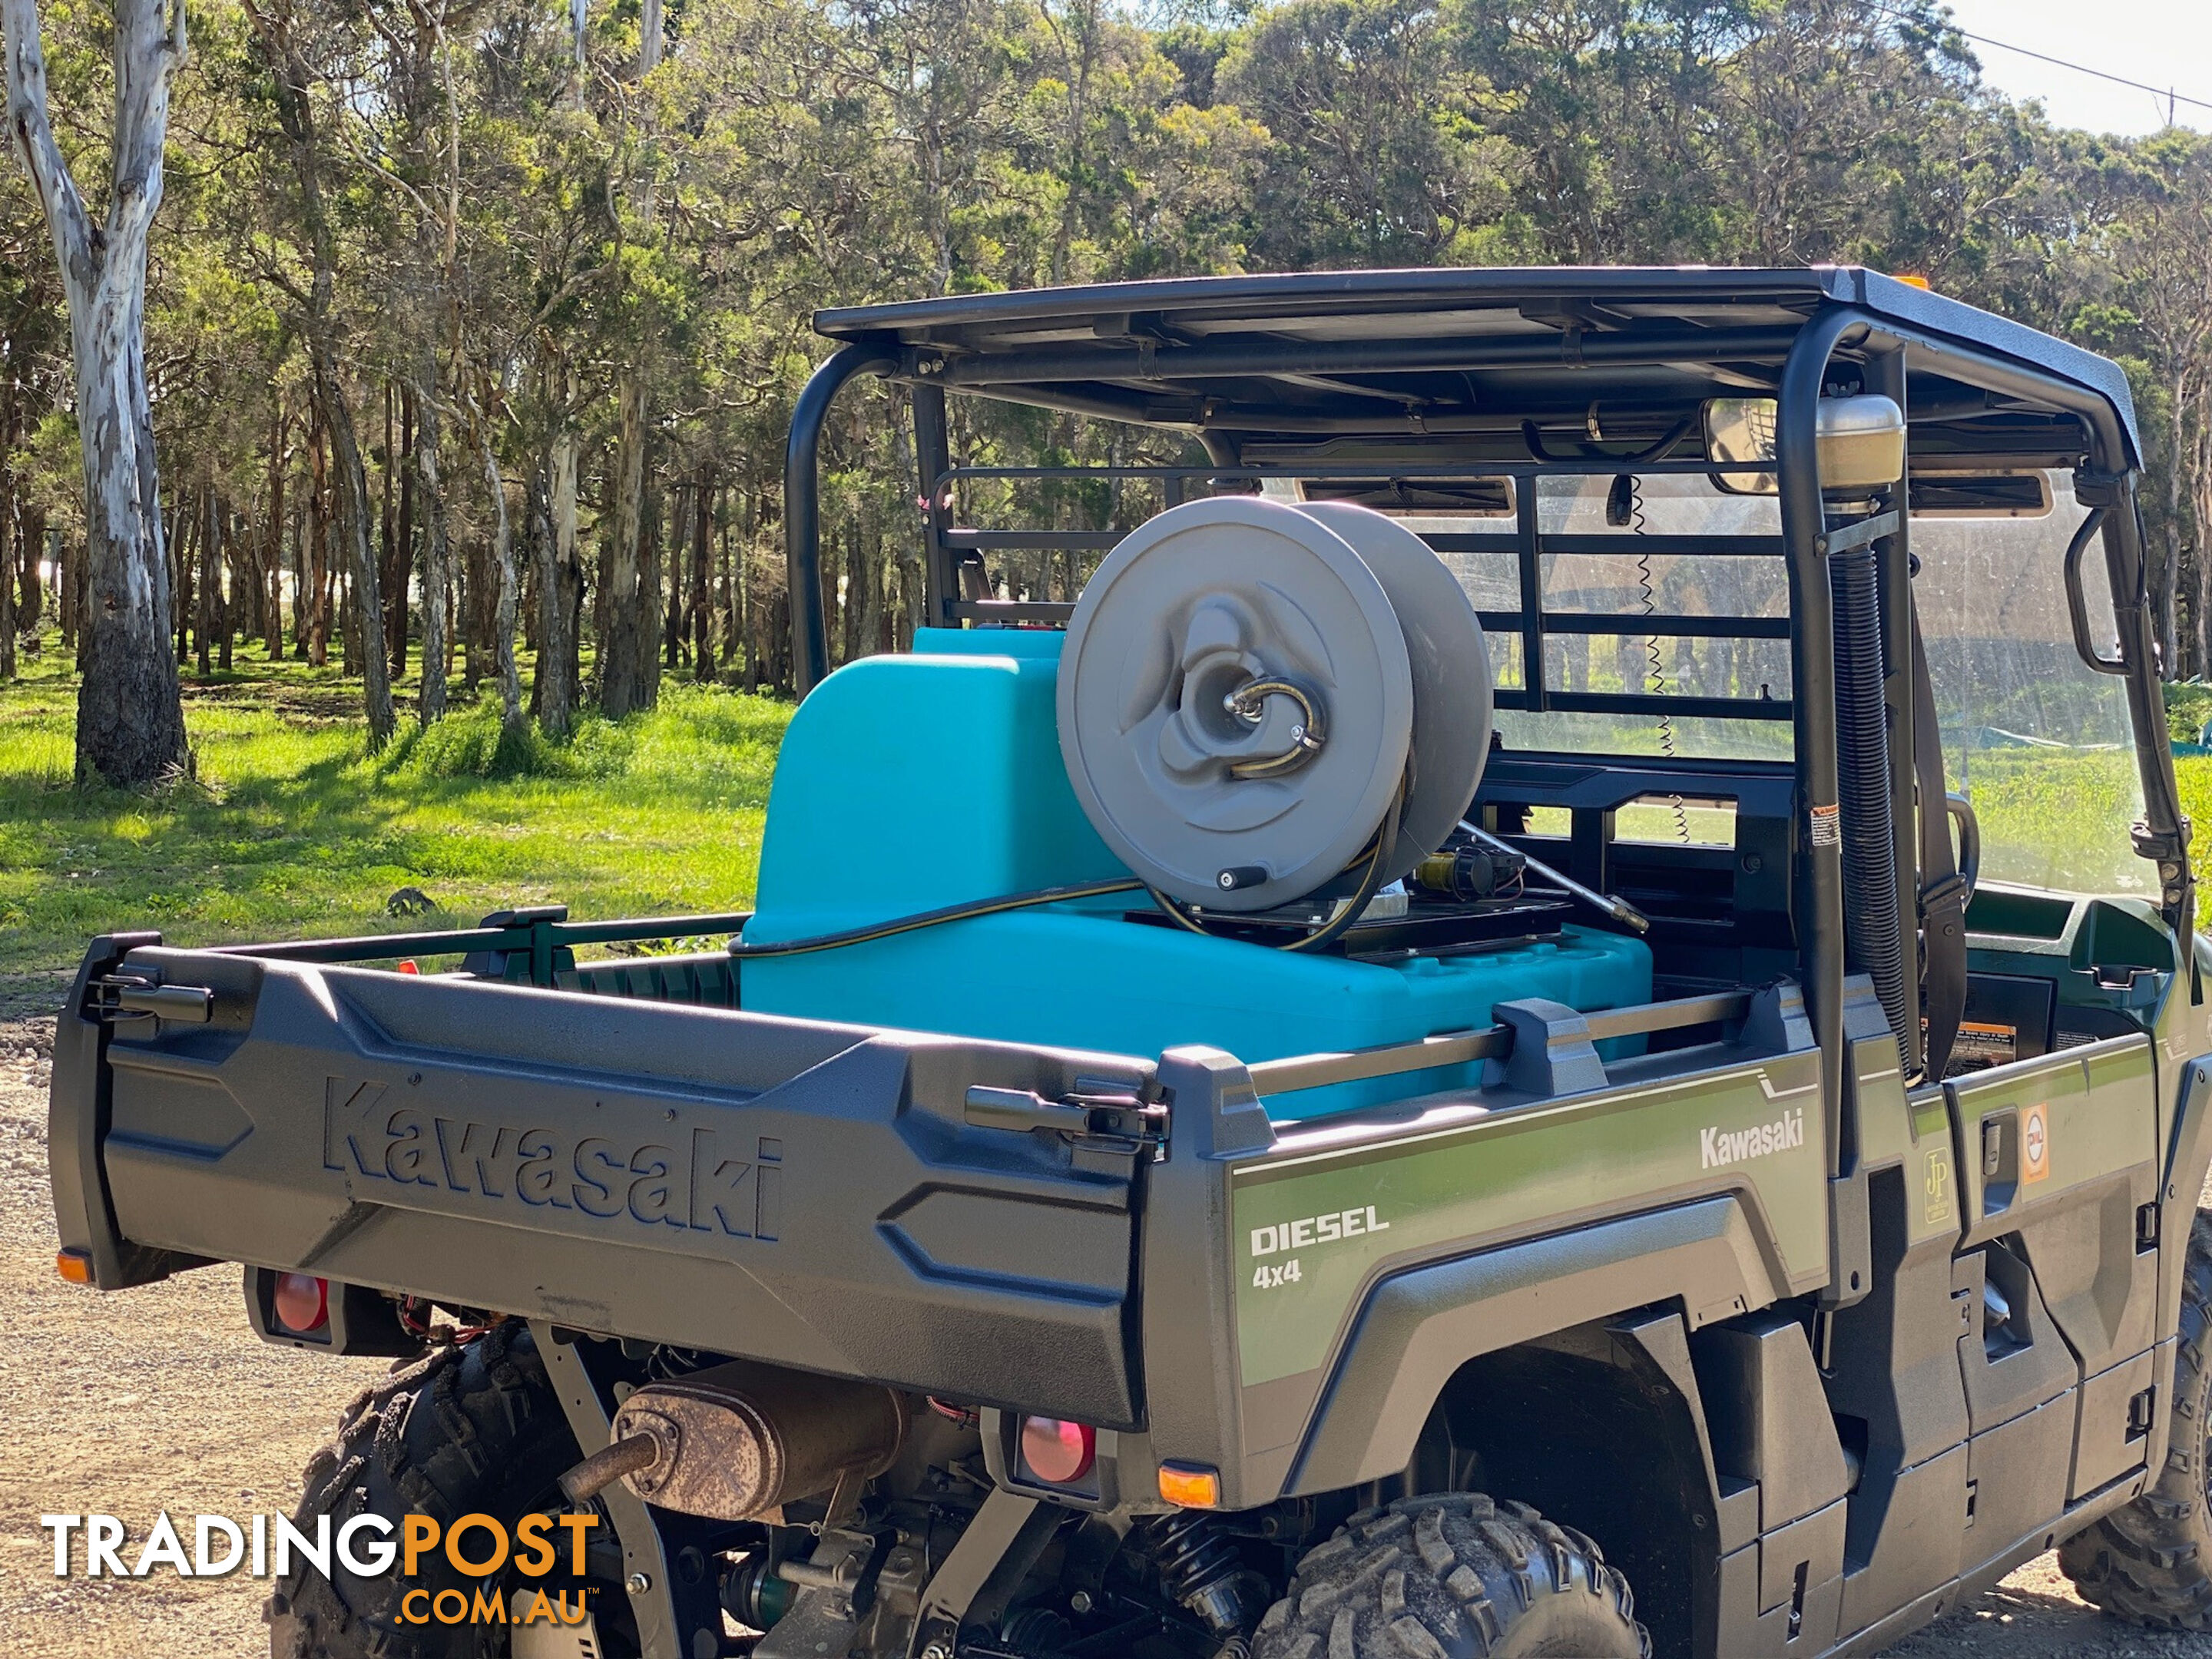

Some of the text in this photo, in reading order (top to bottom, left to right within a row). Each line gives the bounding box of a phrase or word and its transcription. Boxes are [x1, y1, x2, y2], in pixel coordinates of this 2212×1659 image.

[323, 1076, 783, 1241] Kawasaki
[1700, 1108, 1803, 1169] Kawasaki
[1251, 1205, 1389, 1257] DIESEL
[1253, 1258, 1303, 1290] 4x4
